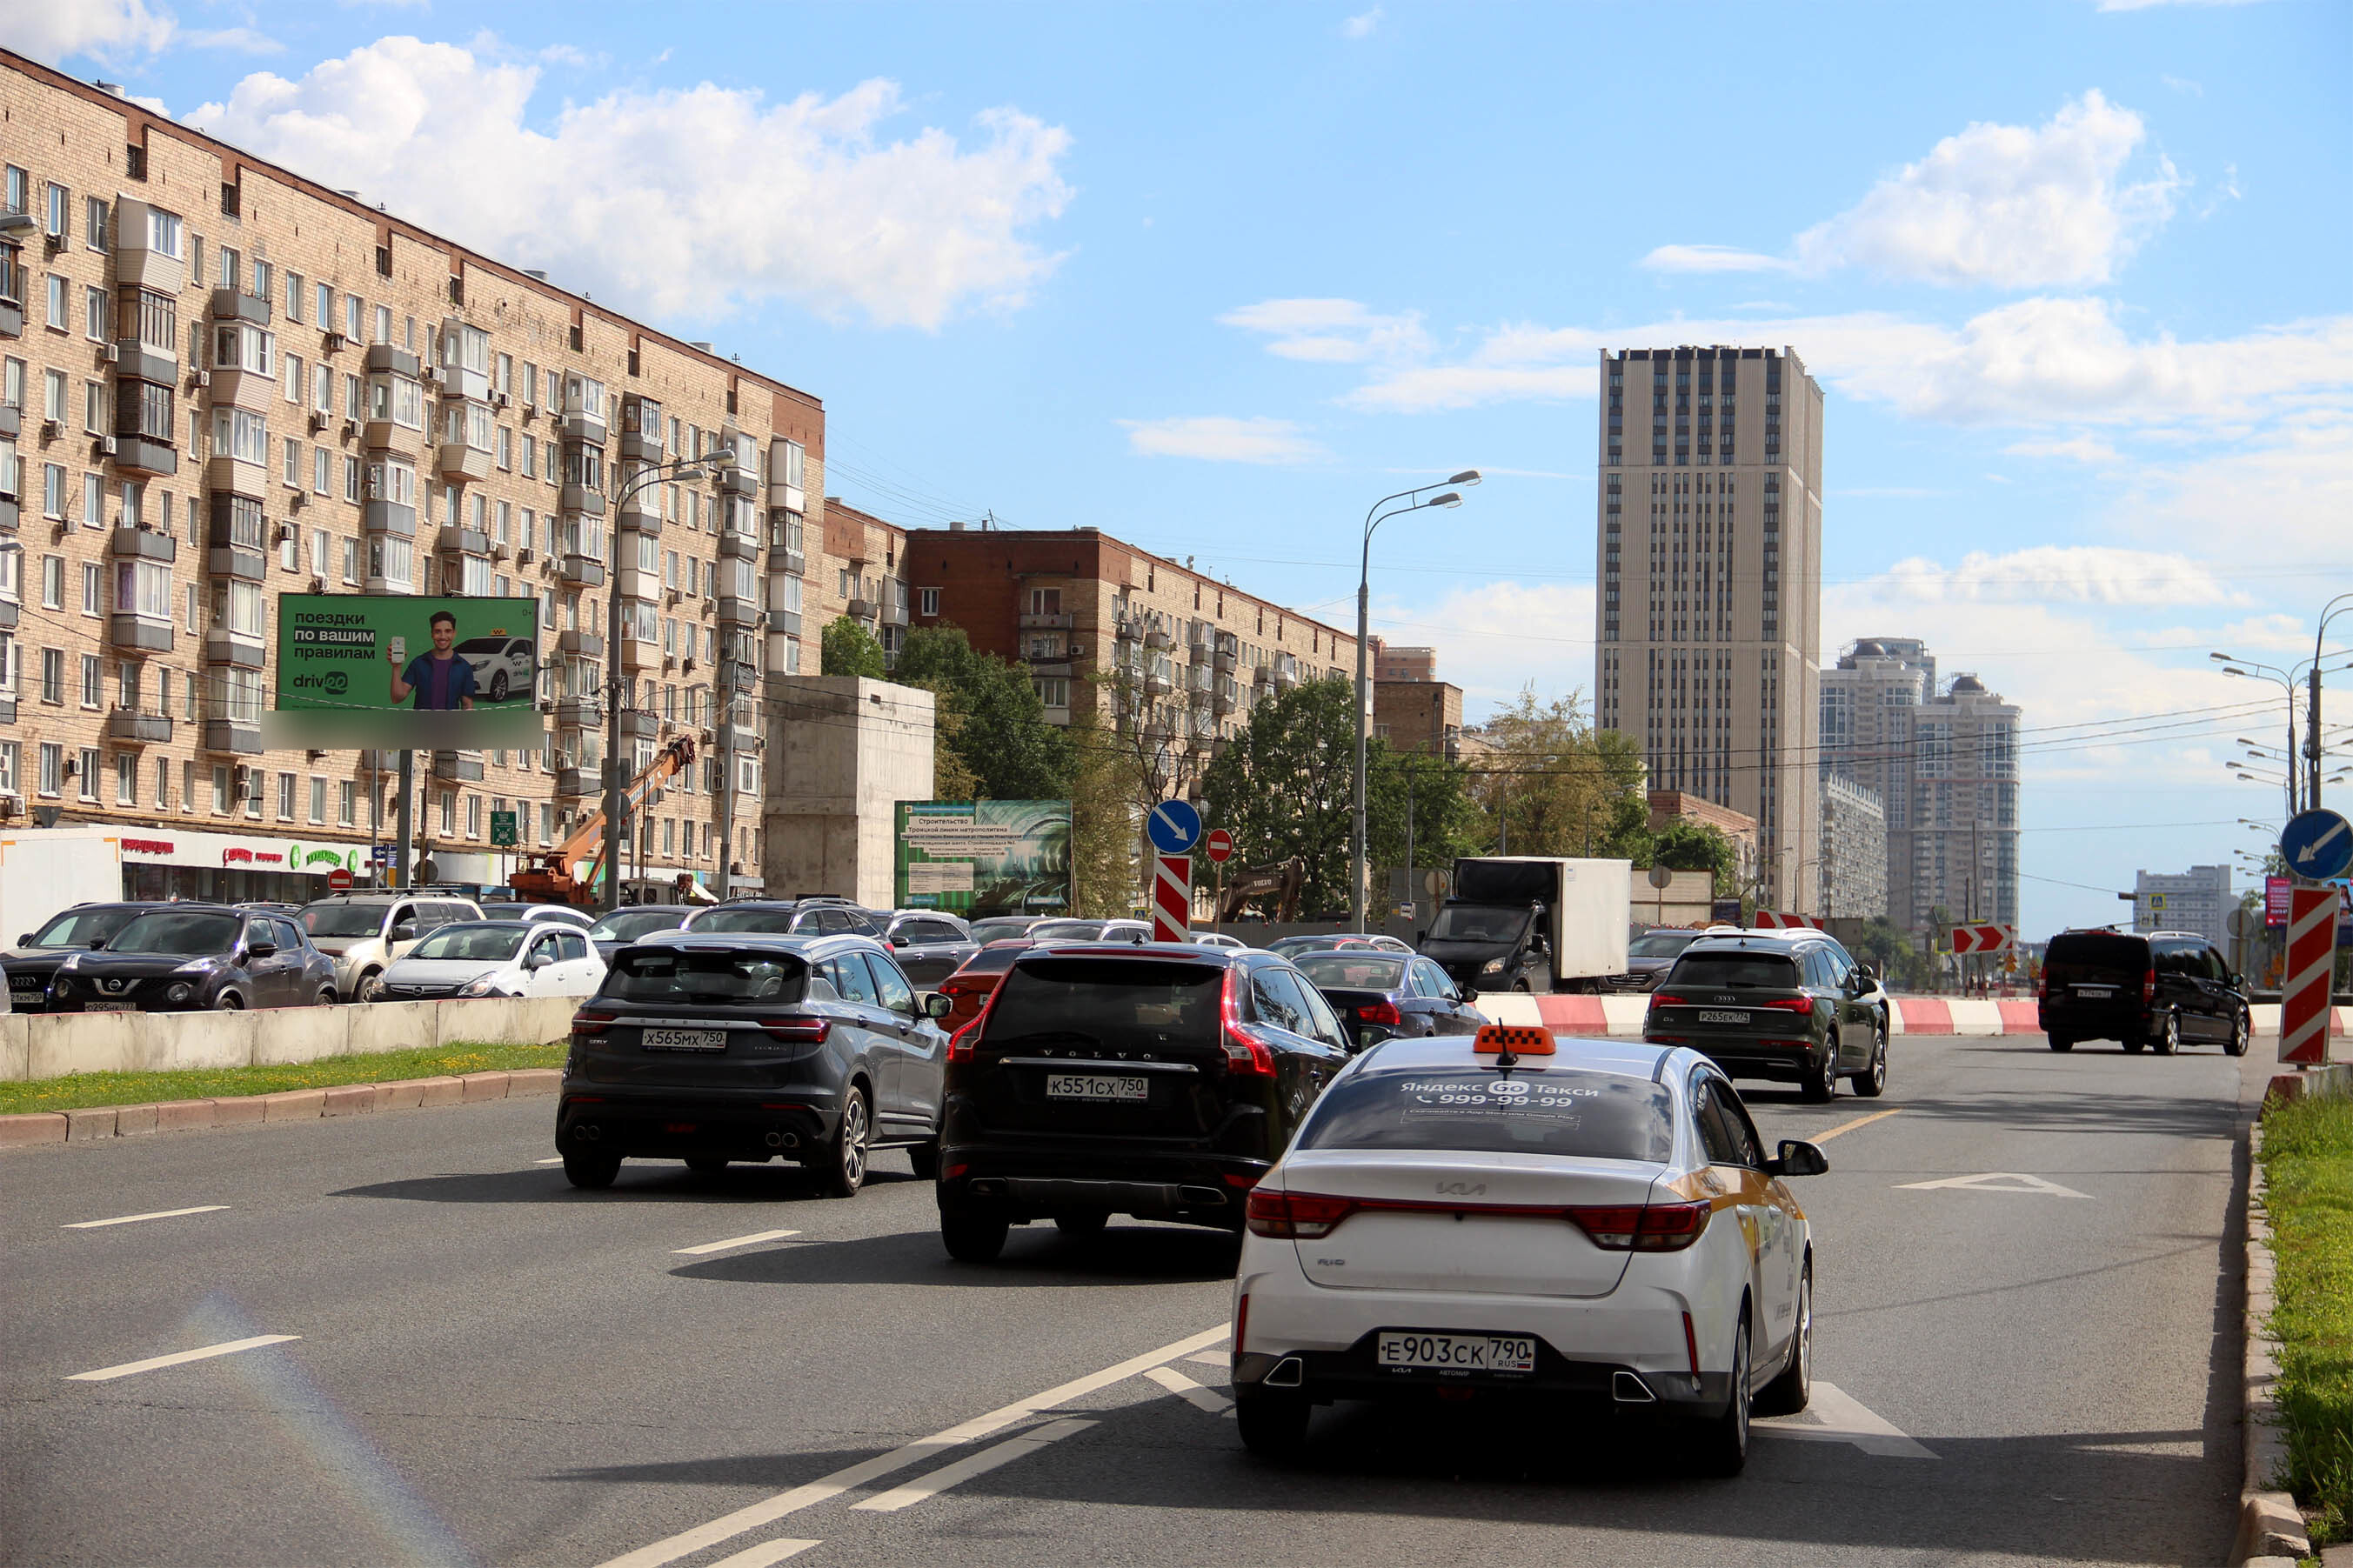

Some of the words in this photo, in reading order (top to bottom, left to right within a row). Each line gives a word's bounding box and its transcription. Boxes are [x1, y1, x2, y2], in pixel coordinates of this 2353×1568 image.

[295, 612, 365, 626] поездки
[294, 630, 315, 641] по
[319, 631, 376, 643] вашим
[294, 647, 376, 661] правилам
[702, 1031, 724, 1043] 750
[1043, 1050, 1152, 1060] VOLVO
[1120, 1078, 1145, 1091] 750
[1400, 1082, 1483, 1093] Яндекс
[1534, 1084, 1600, 1097] Такси
[1439, 1093, 1573, 1108] 999-99-99
[1490, 1339, 1528, 1360] 790
[1498, 1359, 1517, 1368] RUS
